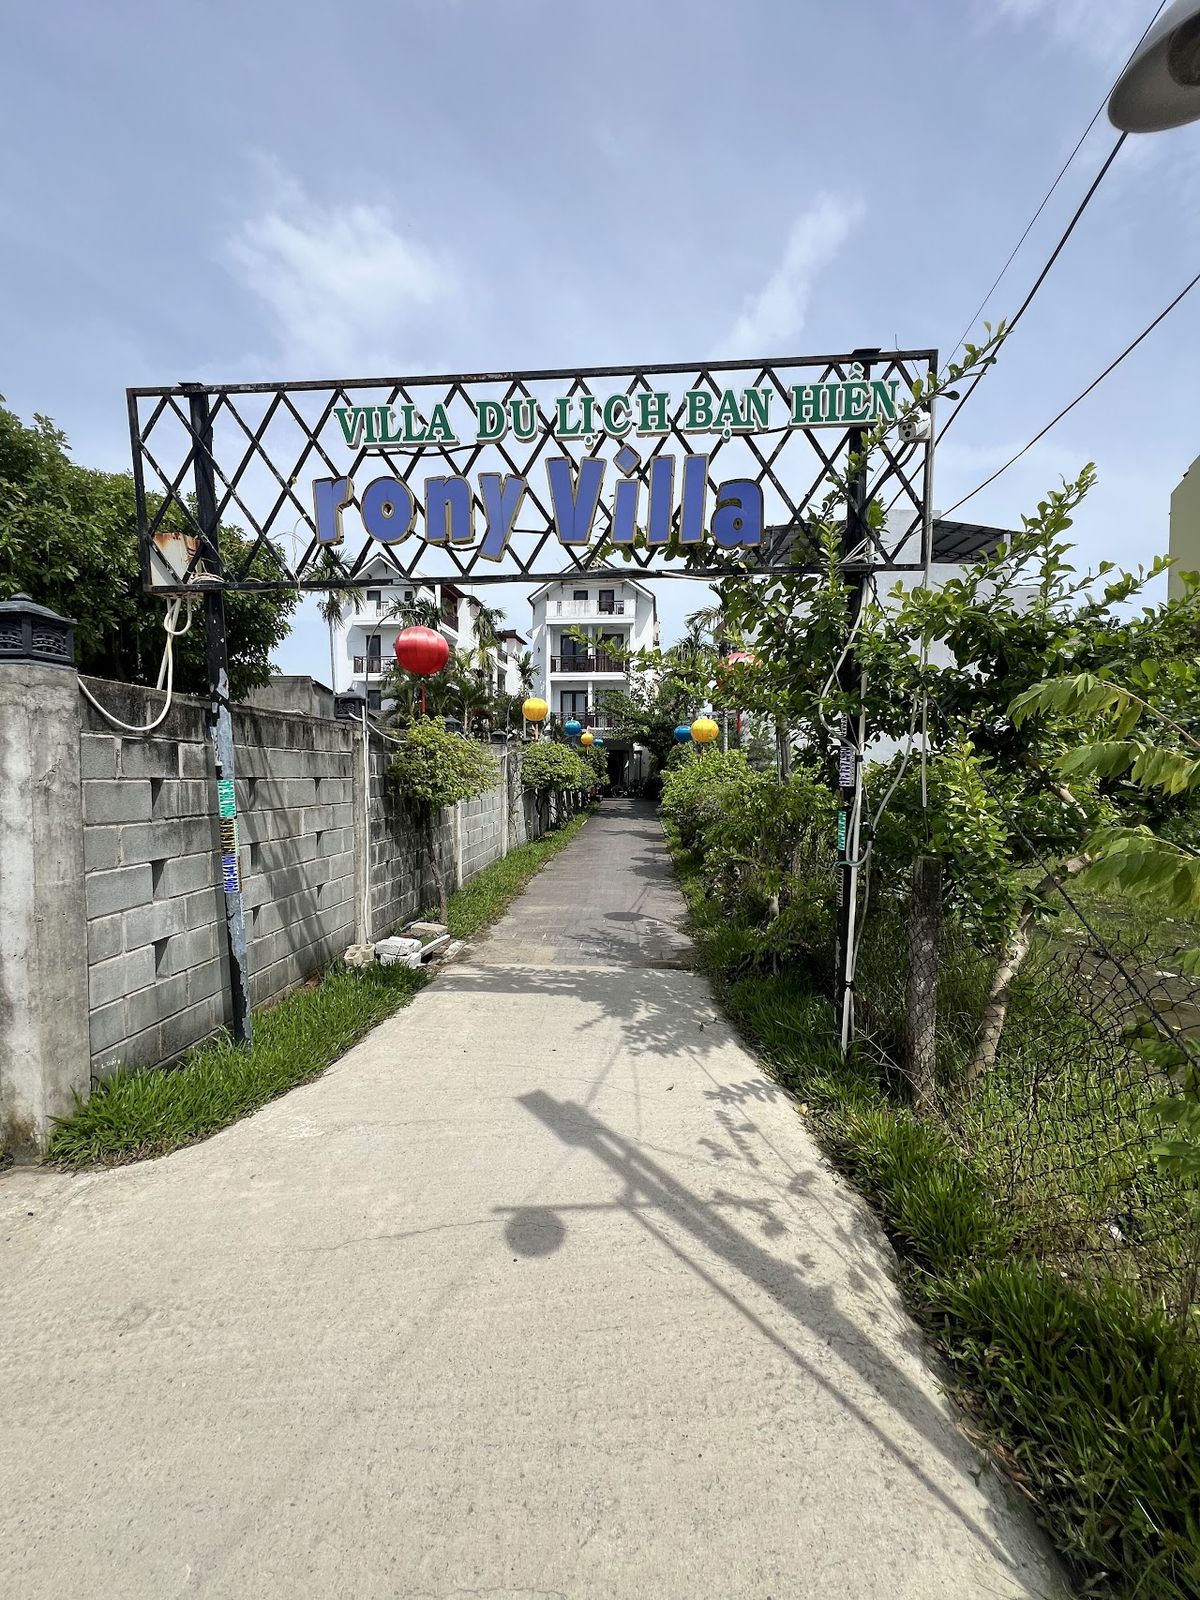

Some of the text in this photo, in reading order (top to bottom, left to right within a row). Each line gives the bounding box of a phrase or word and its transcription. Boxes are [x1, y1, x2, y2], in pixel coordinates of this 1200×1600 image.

[332, 361, 901, 449] VILLA DU LỊCH BẠN HIỀN
[312, 452, 765, 563] rony Villa
